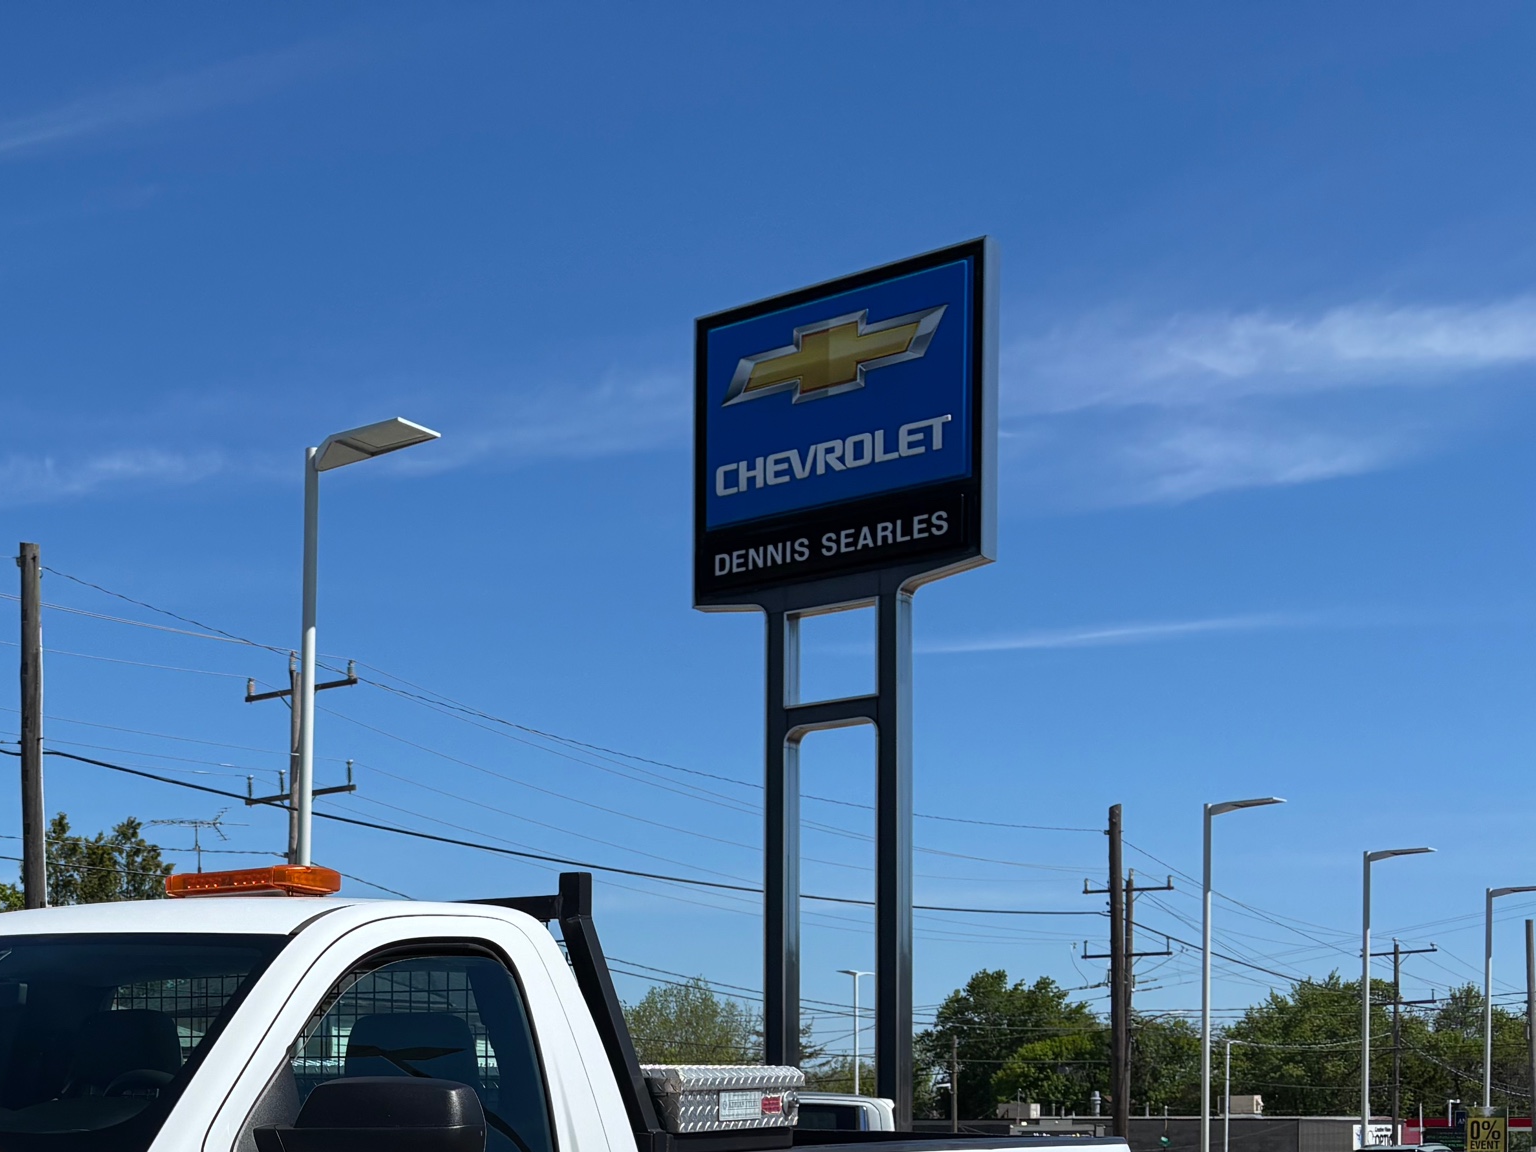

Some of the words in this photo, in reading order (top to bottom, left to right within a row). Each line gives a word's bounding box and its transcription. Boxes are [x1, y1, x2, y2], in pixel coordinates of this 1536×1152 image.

[715, 413, 952, 497] CHEVROLET
[714, 537, 810, 577] DENNIS
[821, 510, 949, 557] SEARLES
[1470, 1120, 1501, 1140] 0%
[1470, 1140, 1500, 1150] EVENT
